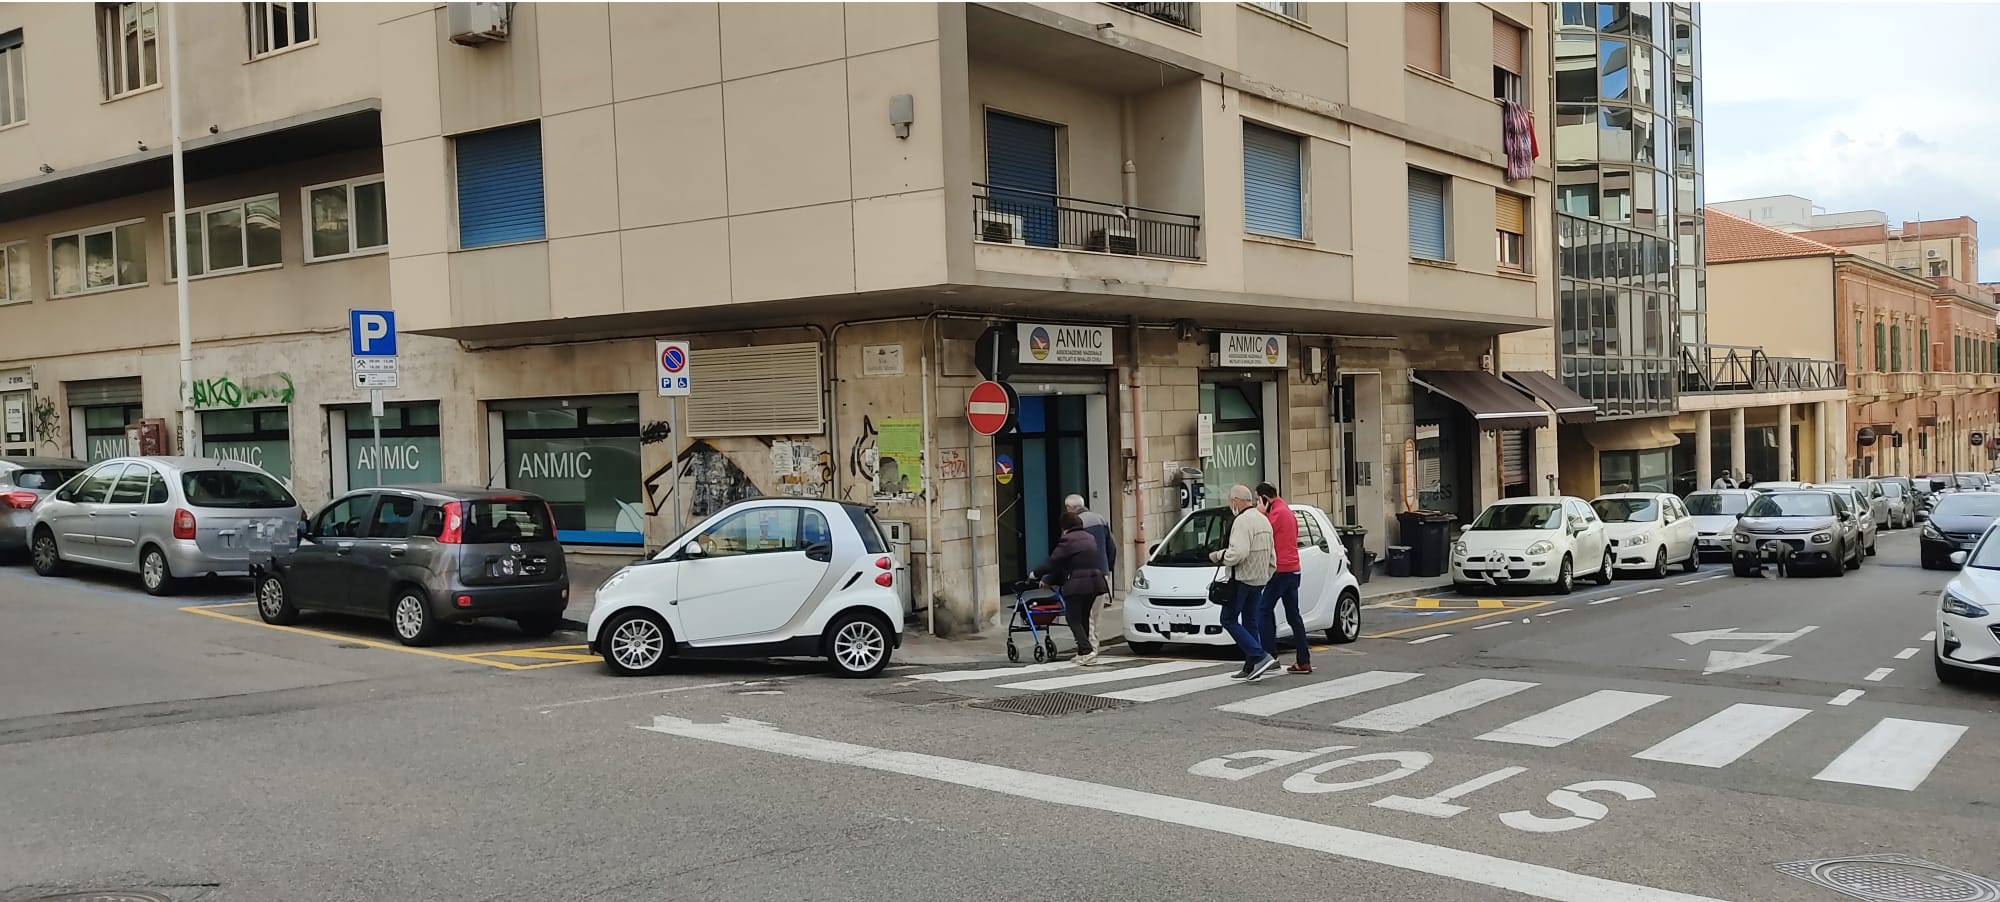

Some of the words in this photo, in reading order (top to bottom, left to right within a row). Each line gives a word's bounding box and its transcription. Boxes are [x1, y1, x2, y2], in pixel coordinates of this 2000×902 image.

[360, 314, 387, 352] P
[1056, 328, 1102, 349] ANMIC
[1229, 335, 1262, 353] ANMIC
[663, 378, 670, 388] P
[94, 438, 128, 459] ANMI
[357, 445, 420, 470] ANMIC
[518, 451, 592, 479] ANMIC
[1180, 488, 1188, 506] P
[1187, 745, 1657, 833] STOP
